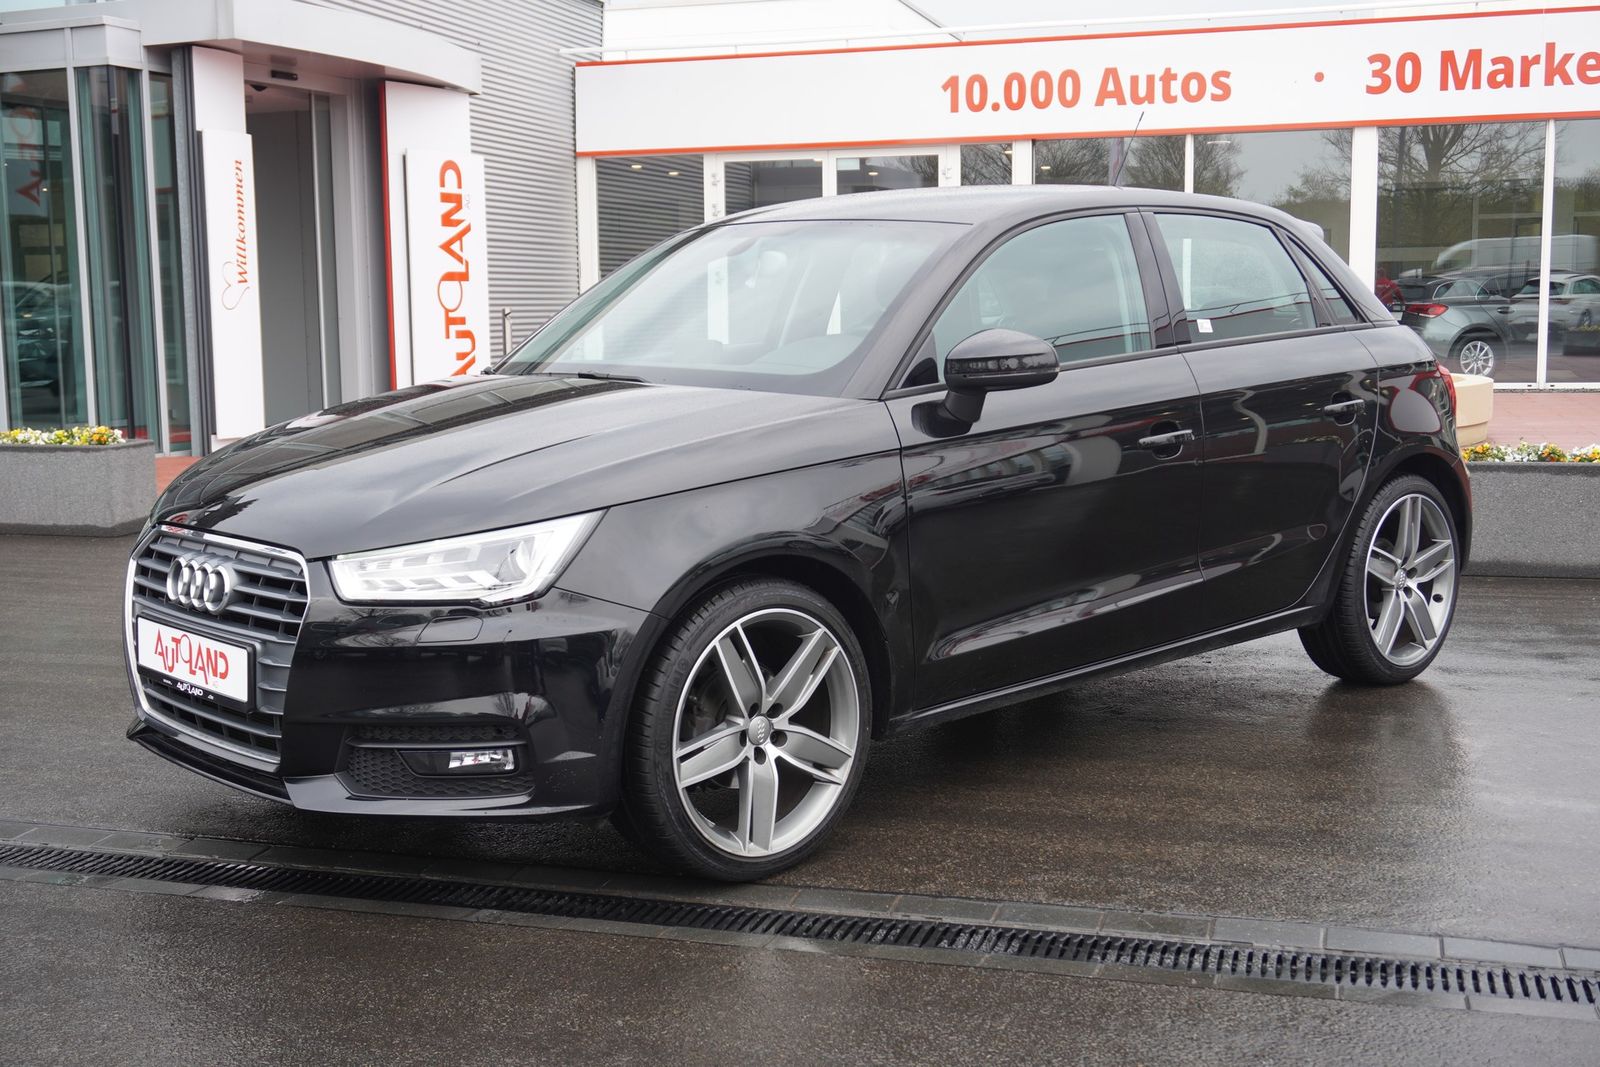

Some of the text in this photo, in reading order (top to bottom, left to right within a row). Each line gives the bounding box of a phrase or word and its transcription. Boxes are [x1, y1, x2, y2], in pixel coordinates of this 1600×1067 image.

[941, 41, 1600, 113] 10.000 Autos 30 Marke
[234, 159, 250, 285] Willkommen
[154, 628, 230, 686] AUTOLAND
